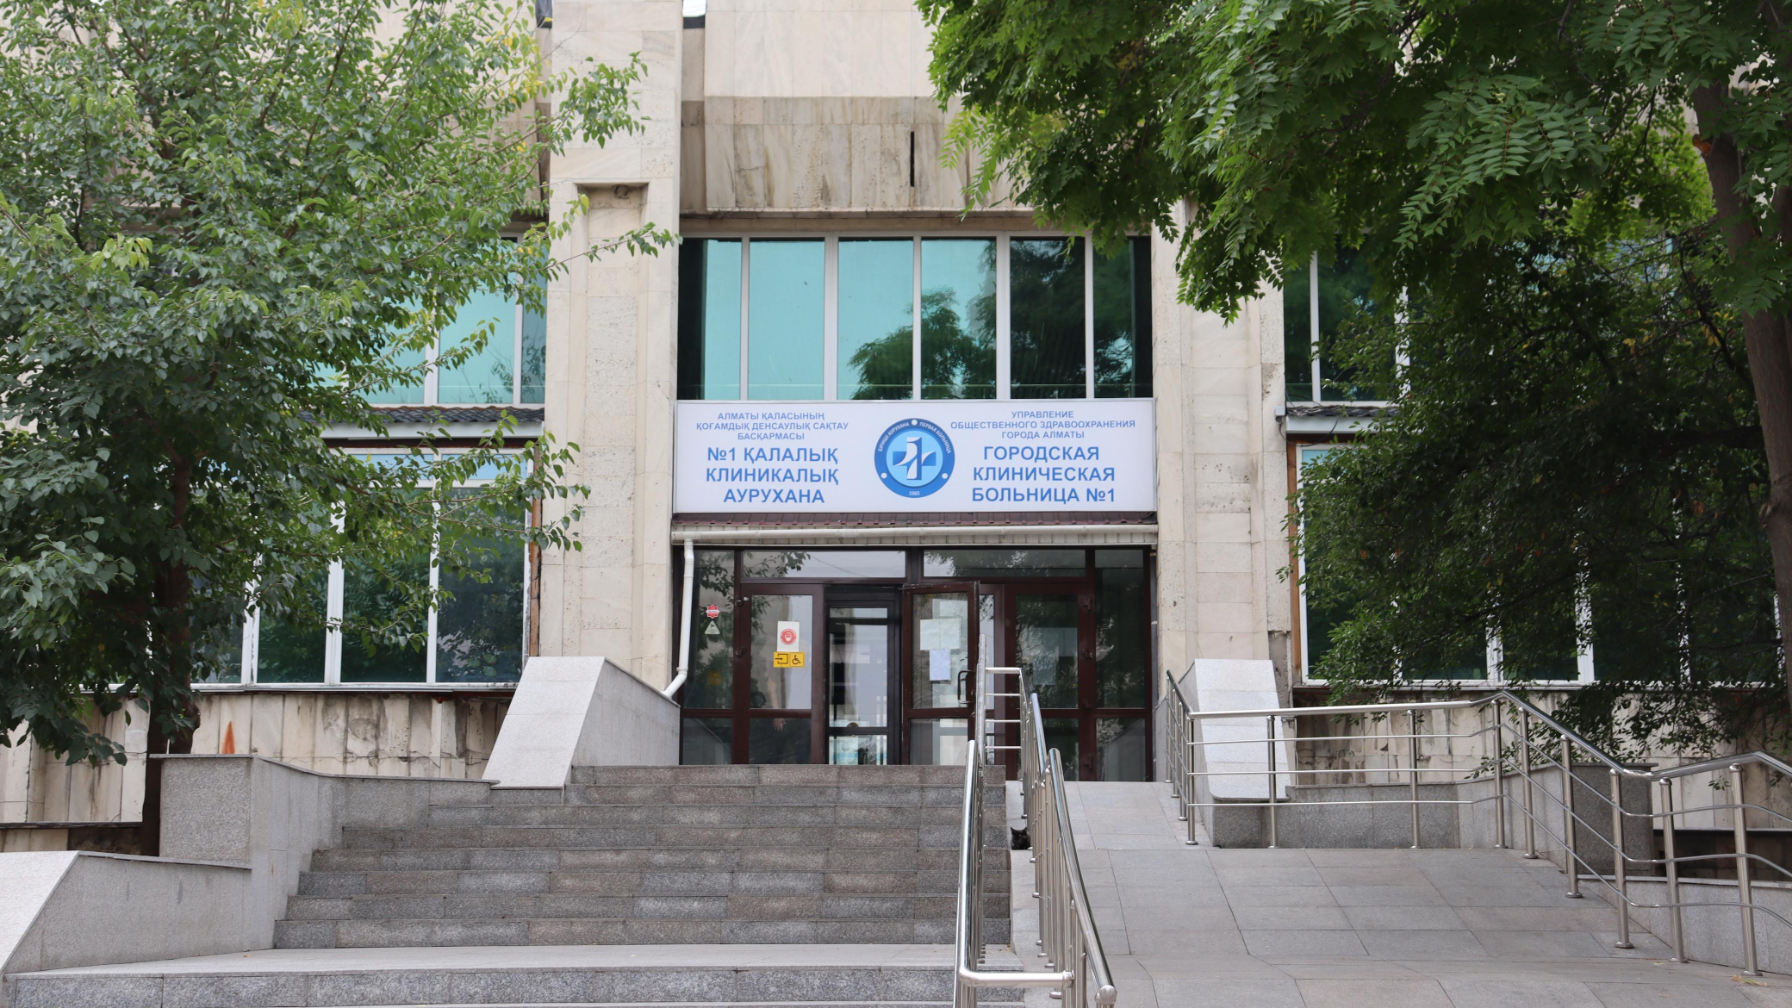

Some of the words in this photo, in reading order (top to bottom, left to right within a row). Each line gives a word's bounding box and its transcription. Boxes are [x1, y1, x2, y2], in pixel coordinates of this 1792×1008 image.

[718, 412, 759, 420] АЛМАТЫ
[762, 412, 825, 421] ҚАЛАСЫНЫҢ
[1011, 410, 1074, 419] УПРАВЛЕНИЕ
[696, 422, 750, 431] ҚОҒАМДЫҚ
[752, 422, 811, 431] ДЕНСАУЛЫҚ
[813, 422, 849, 431] САҚТАУ
[950, 421, 1037, 430] ОБЩЕСТВЕННОГО
[1040, 420, 1136, 429] ЗДРАВООХРАНЕНИЯ
[737, 432, 805, 441] БАСҚАРМАСЫ
[1001, 431, 1040, 440] ГОРОДА
[1043, 431, 1085, 439] АЛМАТЫ
[707, 447, 736, 461] №1
[743, 447, 839, 465] ҚАЛАЛЫҚ
[983, 446, 1100, 463] ГОРОДСКАЯ
[706, 467, 839, 486] КЛИНИКАЛЫҚ
[972, 466, 1116, 482] КЛИНИЧЕСКАЯ
[723, 488, 826, 504] АУРУХАНА
[972, 487, 1080, 505] БОЛЬНИЦА
[1085, 487, 1116, 503] №1
